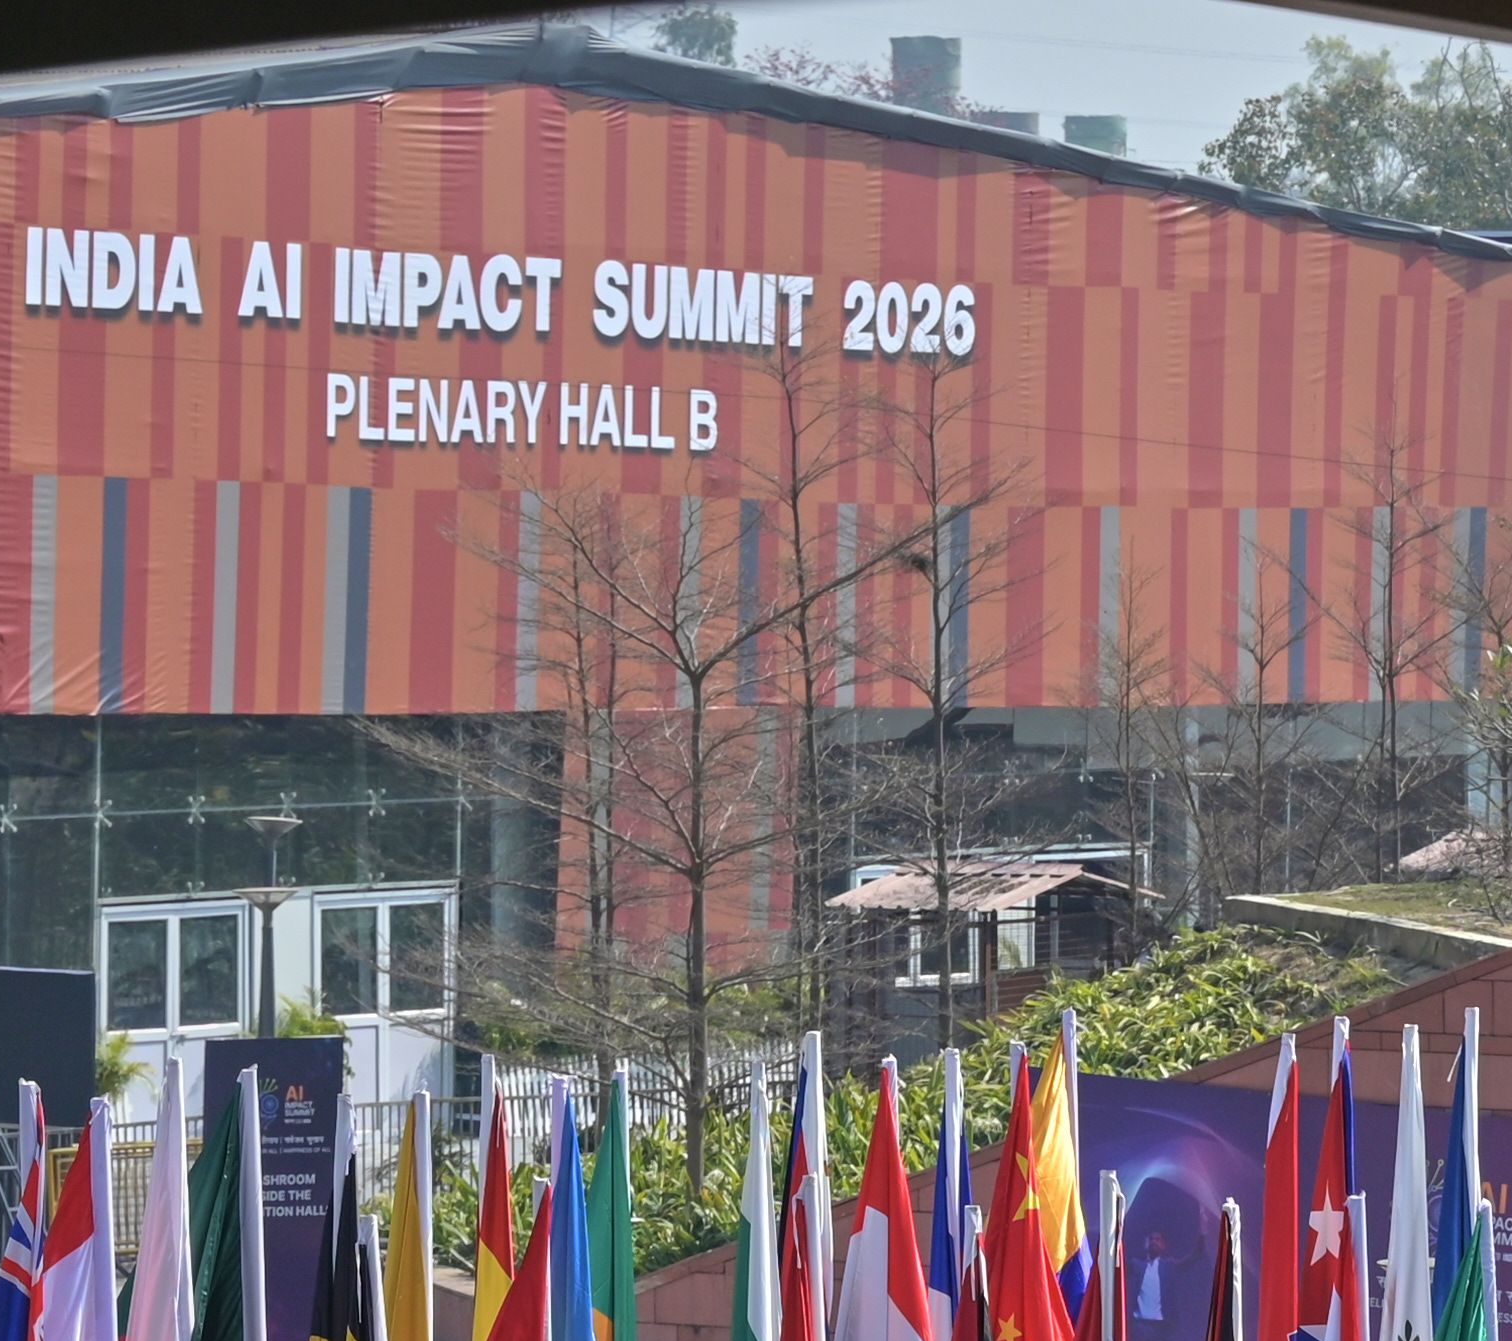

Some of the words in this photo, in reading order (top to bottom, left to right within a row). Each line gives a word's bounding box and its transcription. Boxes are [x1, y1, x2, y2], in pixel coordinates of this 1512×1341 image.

[25, 227, 202, 315] INDIA
[238, 241, 304, 321] AI
[335, 247, 563, 336] IMPACT
[593, 257, 815, 350] SUMMIT
[843, 280, 977, 357] 2026
[326, 372, 549, 447] PLENARY
[559, 382, 677, 451] HALL
[689, 387, 719, 452] B
[286, 1085, 304, 1101] AI
[262, 1173, 316, 1186] SHROOM
[288, 1188, 312, 1201] THE
[264, 1205, 294, 1217] TION
[295, 1204, 328, 1217] HALL
